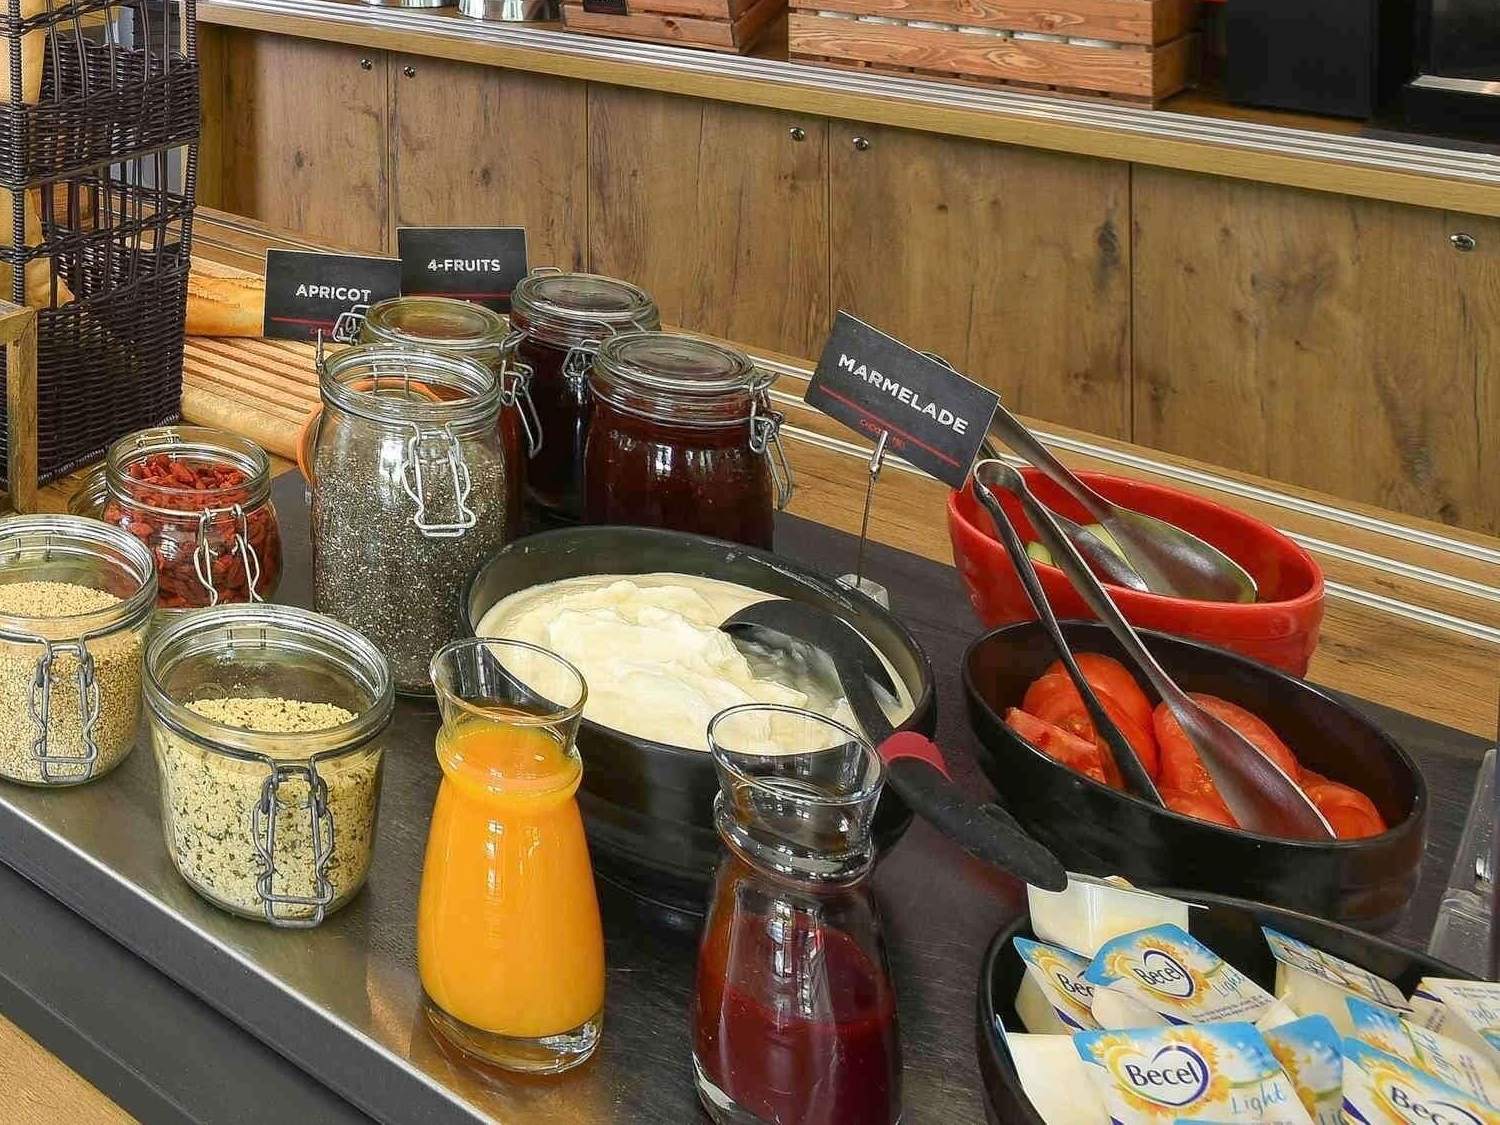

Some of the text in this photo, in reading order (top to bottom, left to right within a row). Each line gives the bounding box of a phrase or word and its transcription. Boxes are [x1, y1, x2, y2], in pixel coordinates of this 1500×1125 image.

[428, 259, 501, 272] 4-FRUITS
[295, 284, 372, 302] APRICOT
[838, 353, 969, 435] MARMELADE
[1056, 972, 1094, 998] Bec
[1132, 962, 1184, 987] Becel
[1125, 1060, 1201, 1087] Becel
[1231, 1081, 1287, 1115] Light
